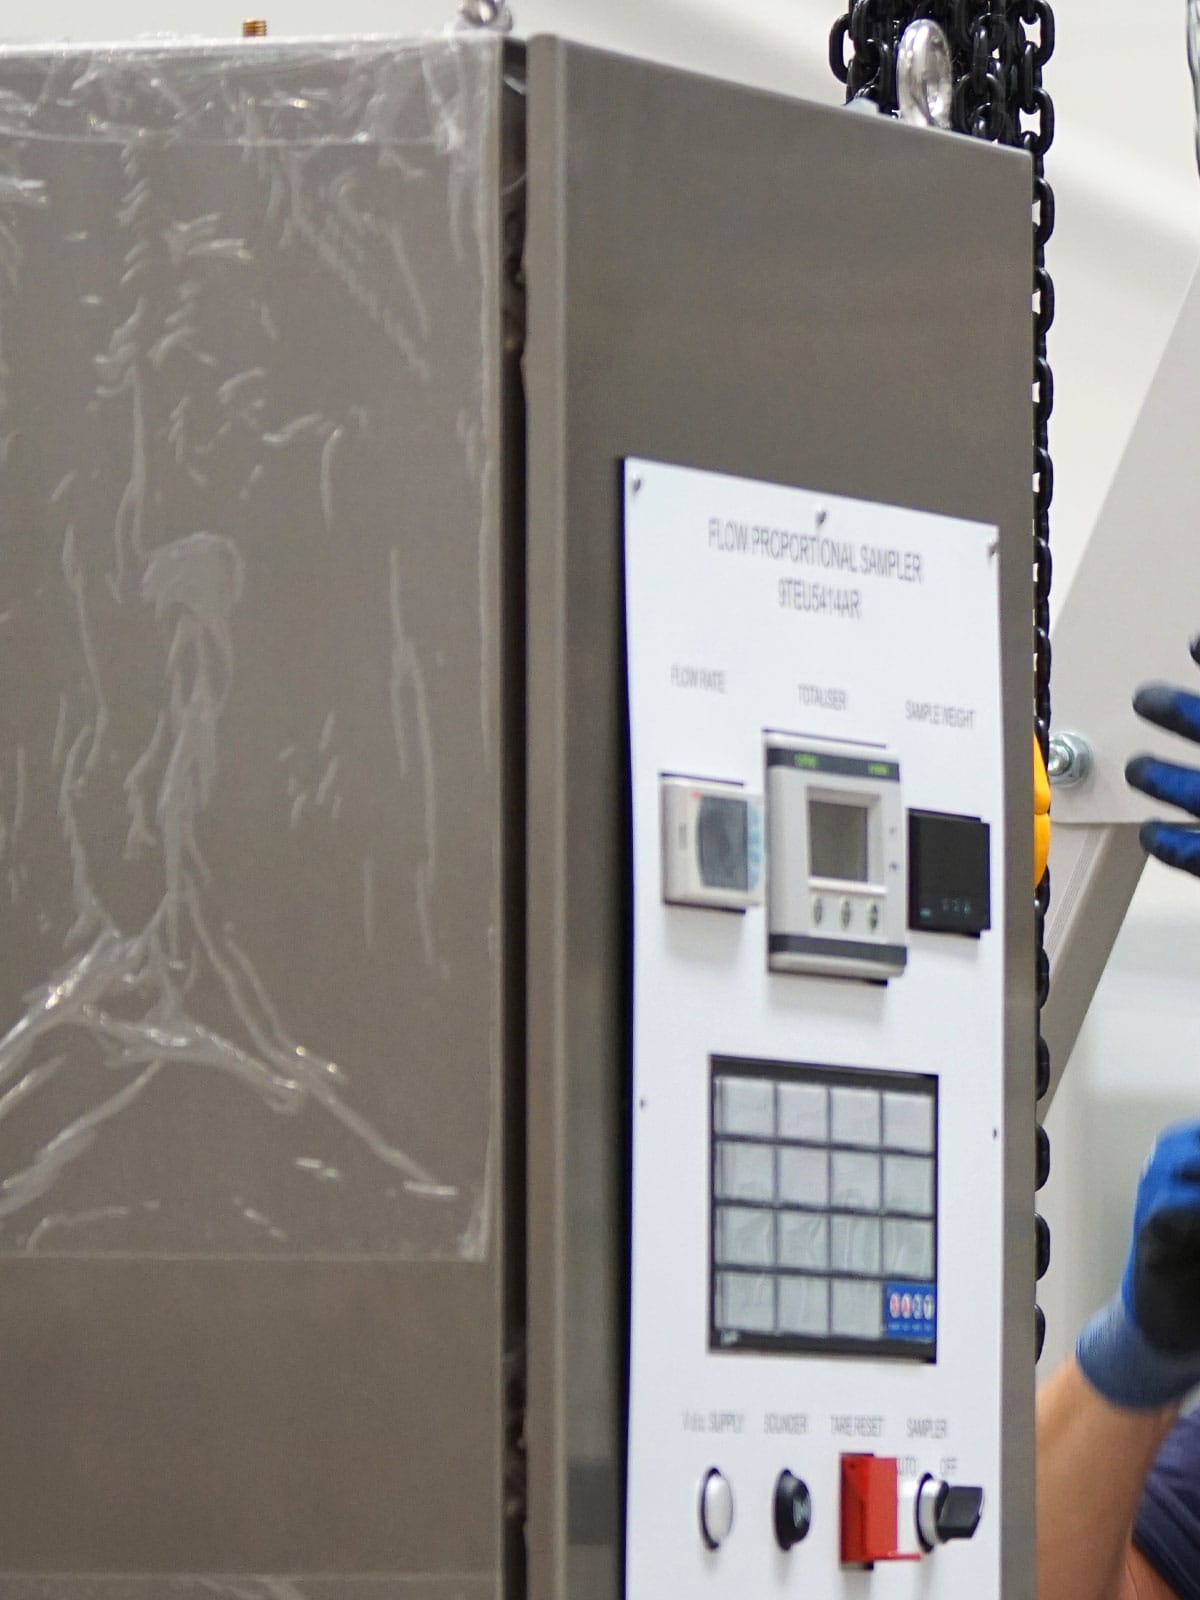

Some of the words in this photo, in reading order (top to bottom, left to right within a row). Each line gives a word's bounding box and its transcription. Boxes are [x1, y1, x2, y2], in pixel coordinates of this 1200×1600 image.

[708, 518, 749, 554] FLOW
[751, 527, 857, 572] PROPORTIONAL
[859, 546, 924, 584] SAMPLER
[670, 664, 698, 690] FLOW
[699, 668, 726, 693] RATE
[895, 1455, 918, 1478] UTO
